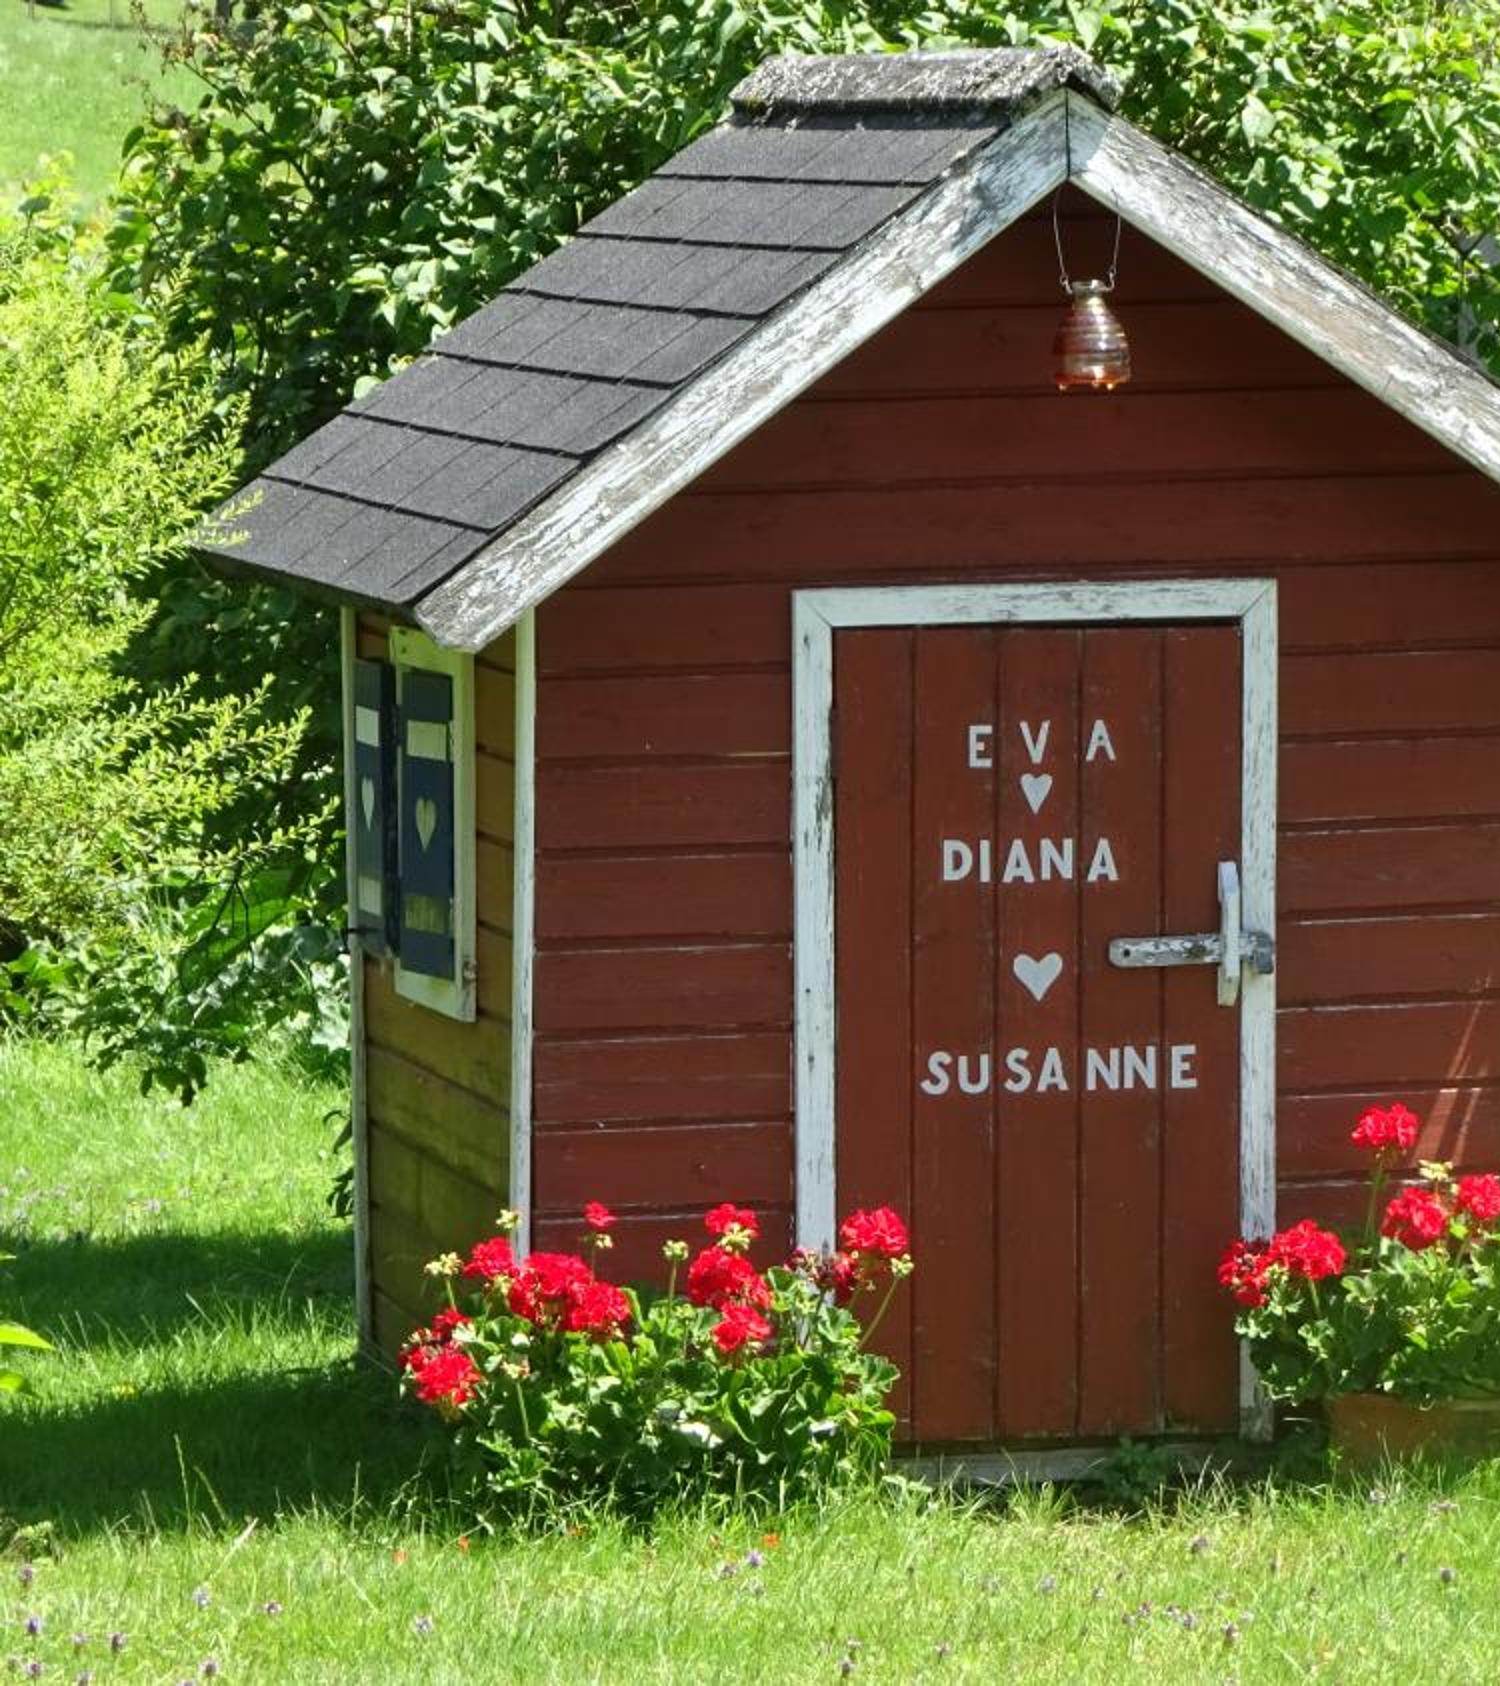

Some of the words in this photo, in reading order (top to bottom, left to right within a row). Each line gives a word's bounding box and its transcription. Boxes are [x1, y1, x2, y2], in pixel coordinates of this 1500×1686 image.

[968, 719, 1117, 768] EVA
[942, 838, 1119, 883] DIANA
[920, 1044, 1198, 1096] SUSANNE
